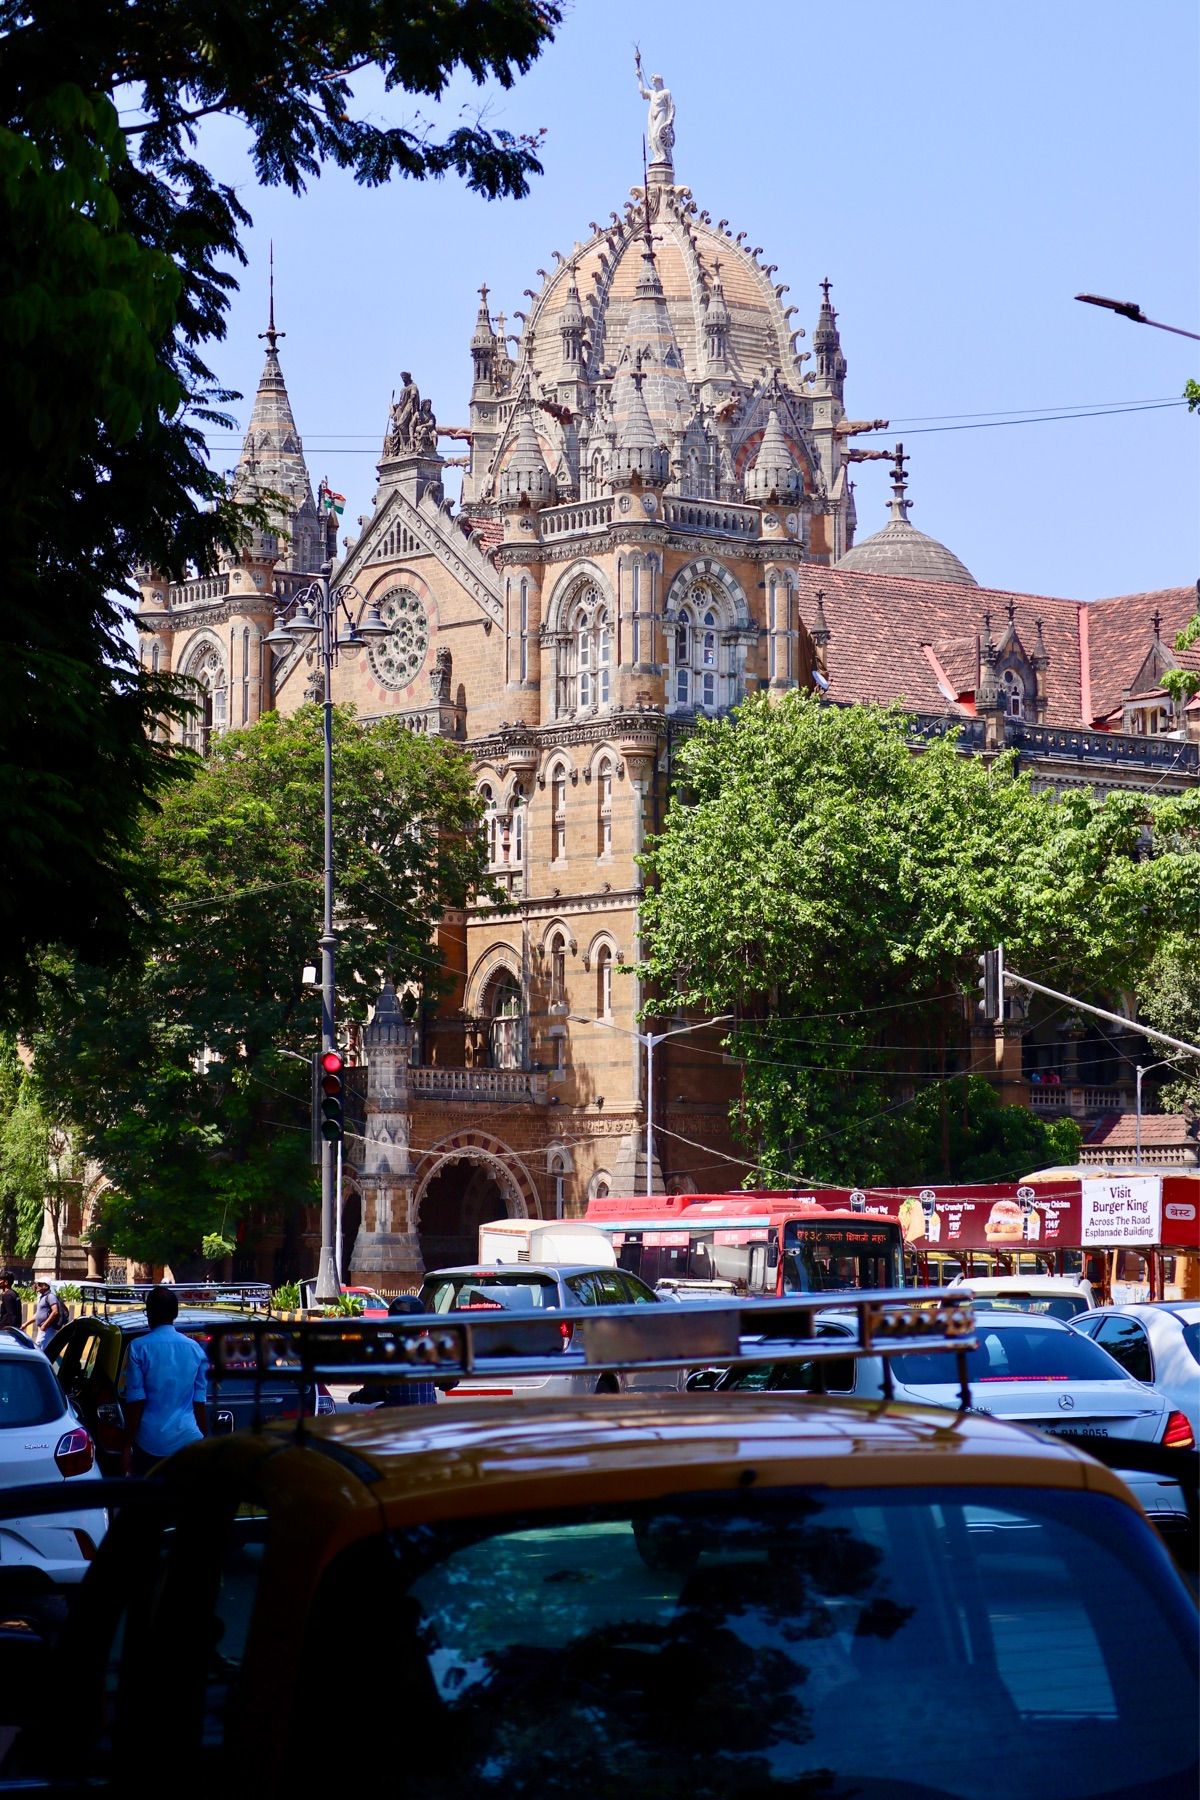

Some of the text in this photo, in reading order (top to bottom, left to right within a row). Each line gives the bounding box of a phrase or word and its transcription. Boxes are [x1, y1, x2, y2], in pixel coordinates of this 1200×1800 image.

[1110, 1186, 1131, 1198] Visit
[1093, 1199, 1149, 1214] Burger King
[1170, 1206, 1191, 1217] बेस्ट
[1089, 1215, 1151, 1226] Across The Road
[1085, 1226, 1154, 1238] Esplanade Building
[1082, 1428, 1108, 1438] 8055
